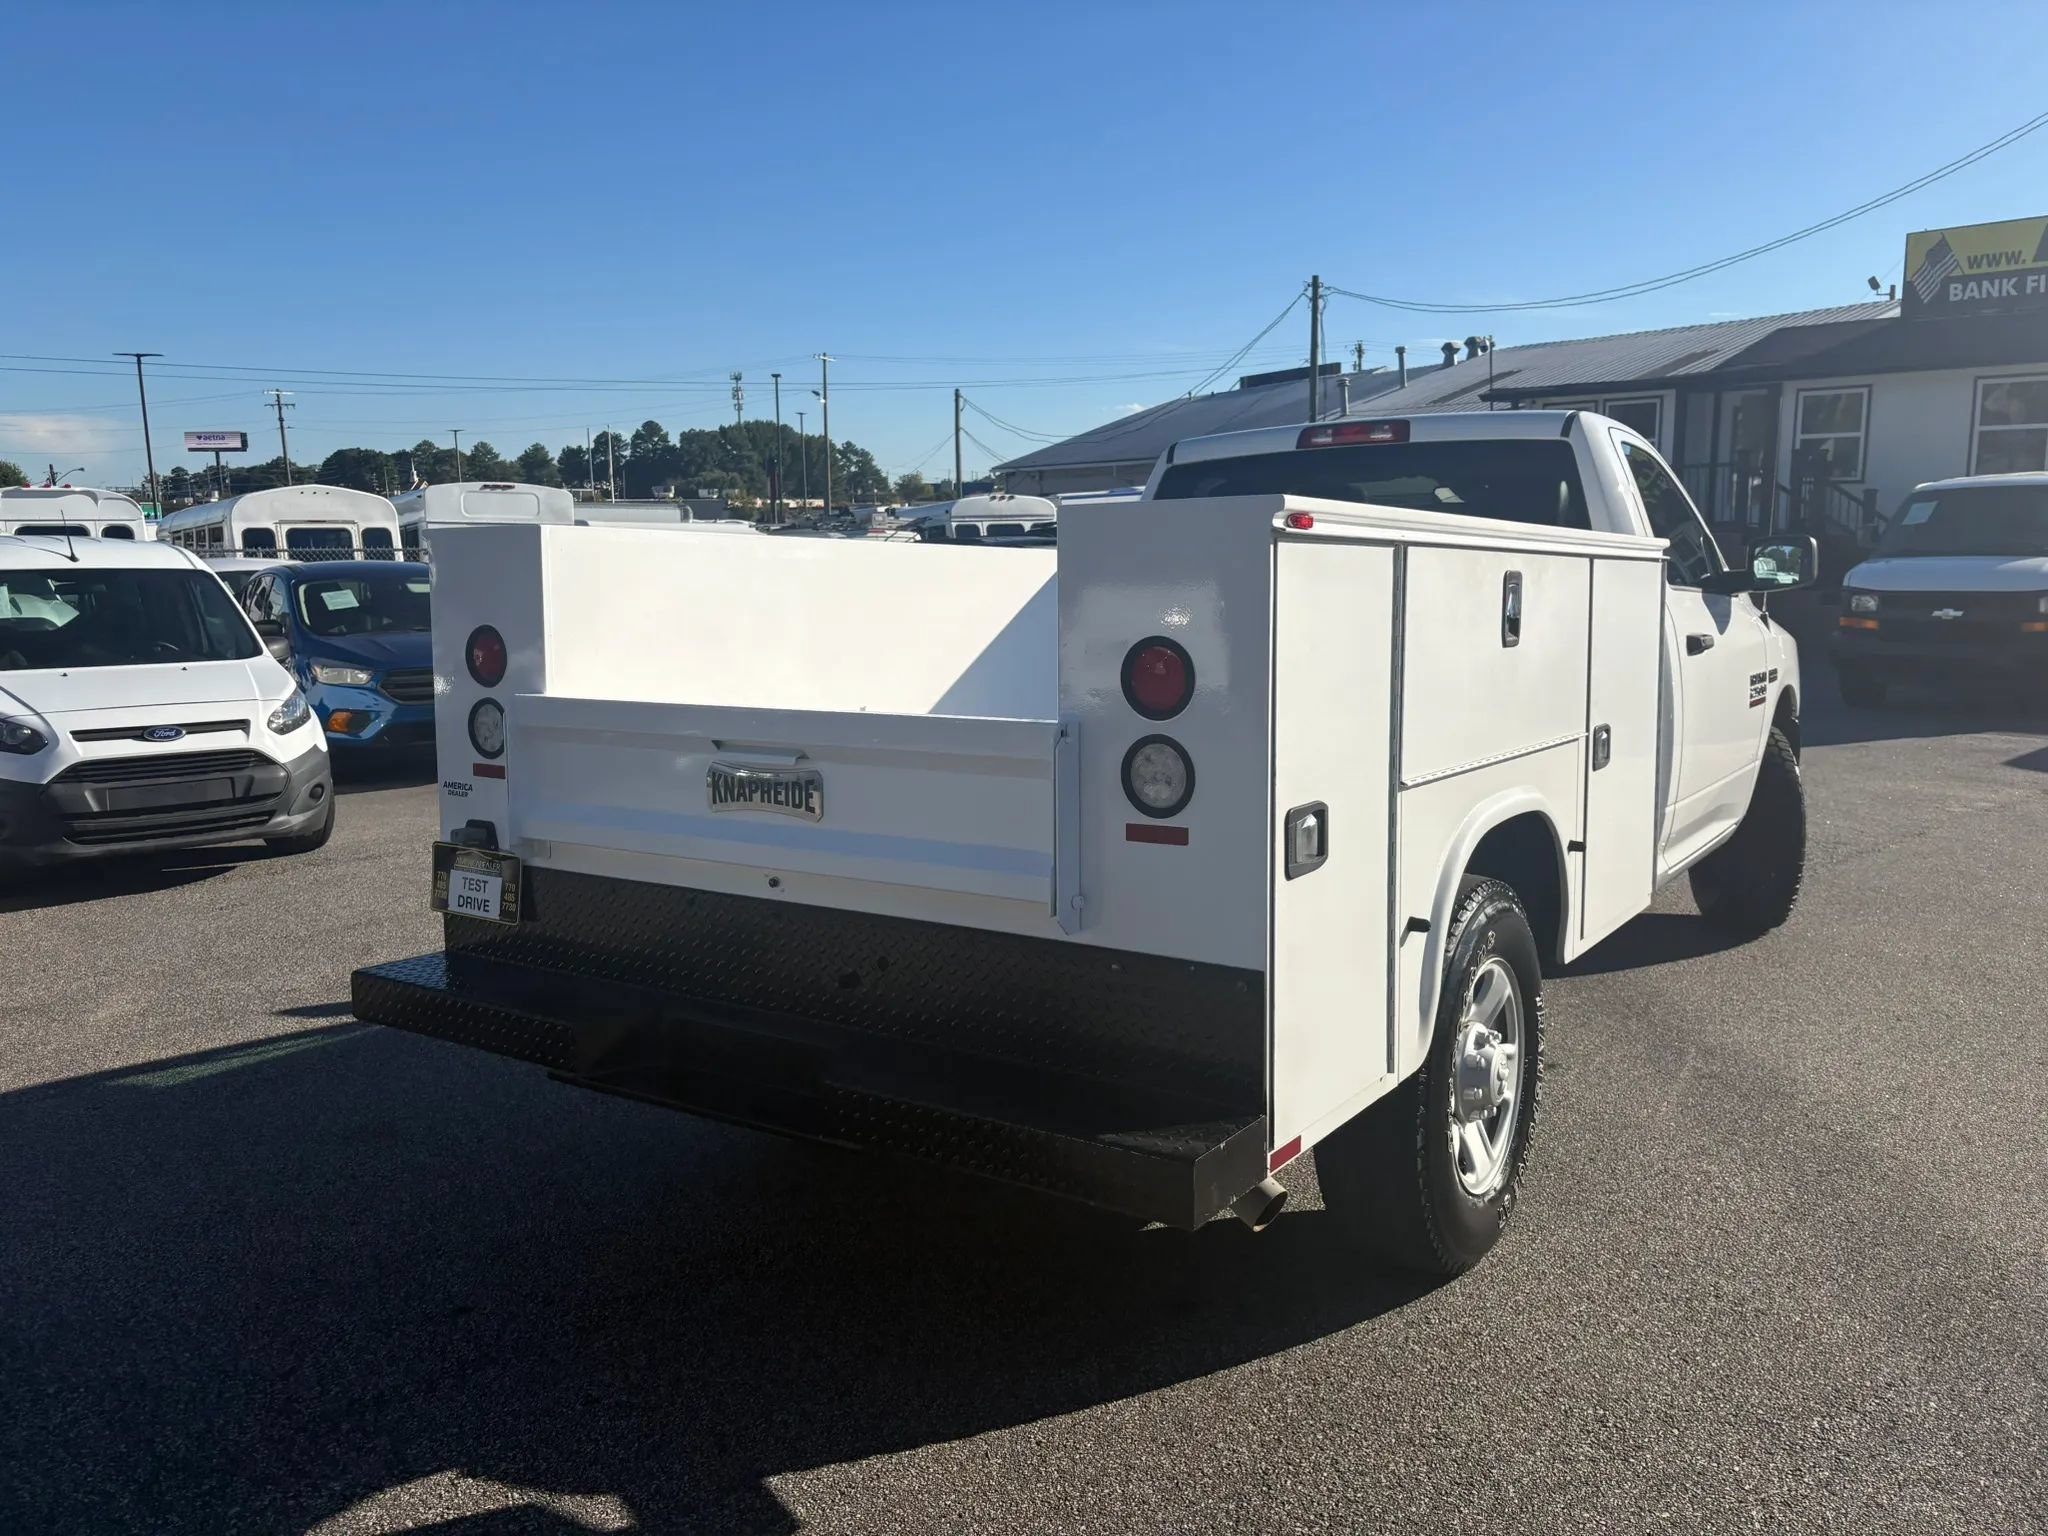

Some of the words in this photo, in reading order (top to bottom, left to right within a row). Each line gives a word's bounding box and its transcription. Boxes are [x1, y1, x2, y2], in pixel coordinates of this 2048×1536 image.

[1950, 276, 2018, 301] BANK
[154, 729, 176, 738] Ford
[443, 780, 473, 791] AMERICA
[448, 789, 468, 798] DEALER
[711, 771, 816, 814] KNAPHEIDE
[462, 876, 489, 894] TEST
[457, 895, 490, 912] DRIVE
